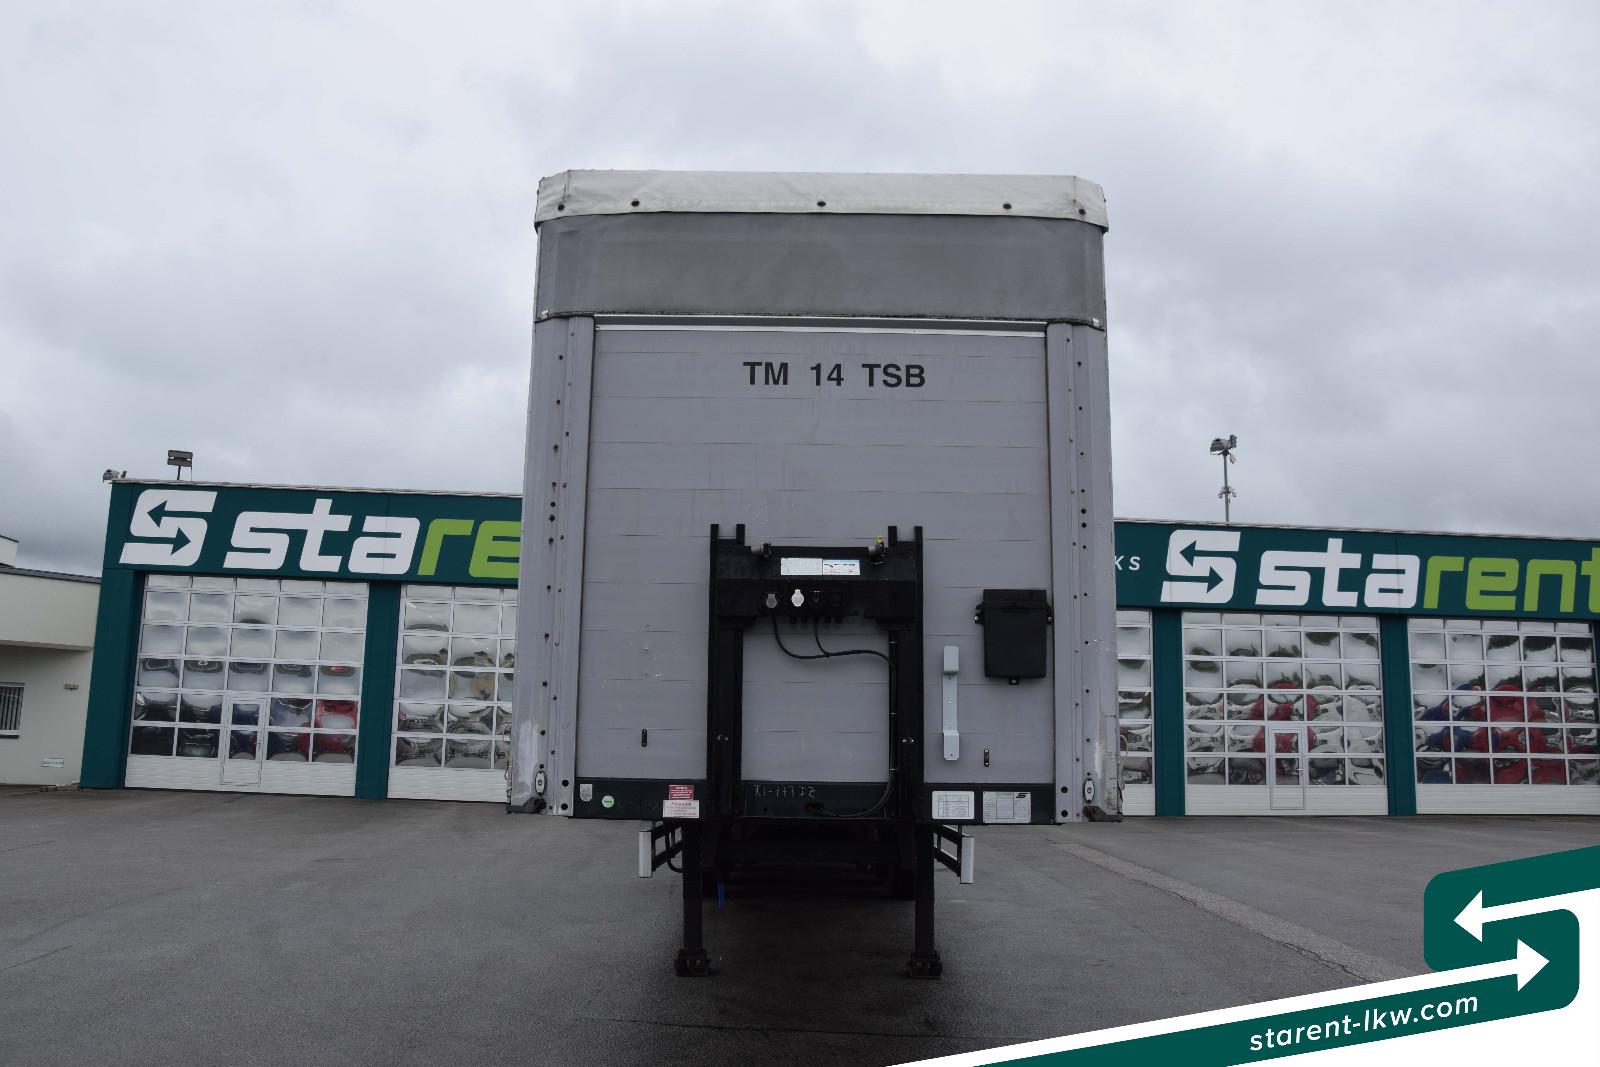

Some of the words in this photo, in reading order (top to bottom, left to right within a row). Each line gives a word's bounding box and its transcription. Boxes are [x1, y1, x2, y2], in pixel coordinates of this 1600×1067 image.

[743, 362, 788, 386] TM
[811, 363, 844, 387] 14
[862, 364, 926, 388] TSB
[1255, 538, 1600, 613] starent
